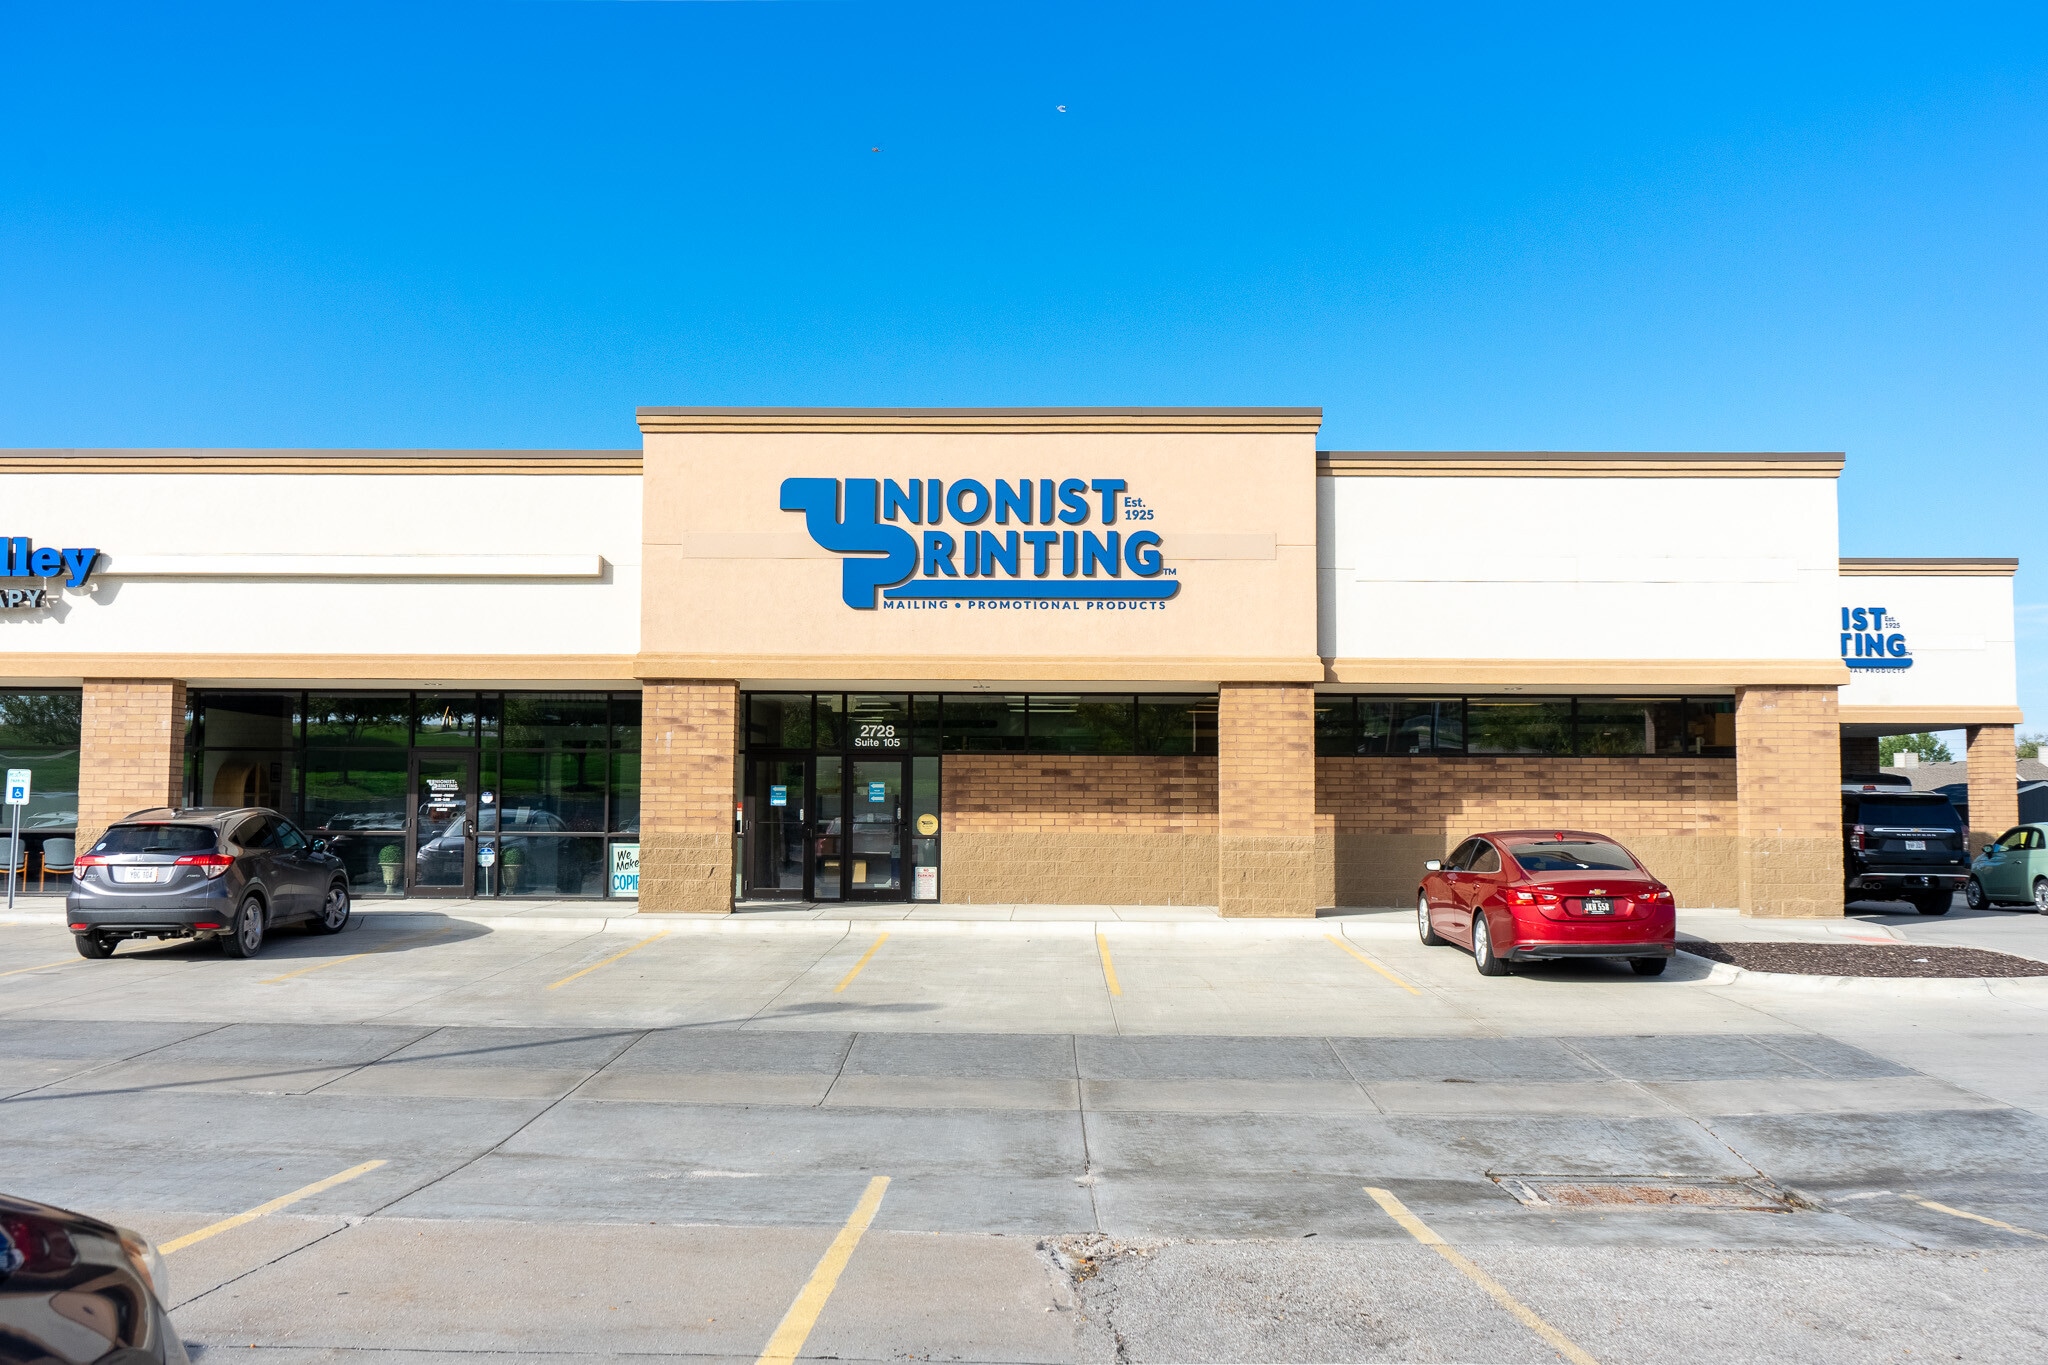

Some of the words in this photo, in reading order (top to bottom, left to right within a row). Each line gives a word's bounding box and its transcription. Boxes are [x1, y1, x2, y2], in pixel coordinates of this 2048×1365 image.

[1124, 497, 1146, 508] Est.
[780, 478, 1126, 552] UNIONIST
[1125, 510, 1154, 521] 1925
[843, 524, 1163, 609] PRINTING
[883, 601, 948, 610] MAILING
[968, 600, 1080, 610] PROMOTIONAL
[1086, 601, 1166, 610] PRODUCTS
[860, 725, 895, 737] 2728
[855, 738, 880, 747] Suite
[883, 738, 901, 747] 105
[618, 850, 631, 861] We
[616, 859, 639, 872] Make
